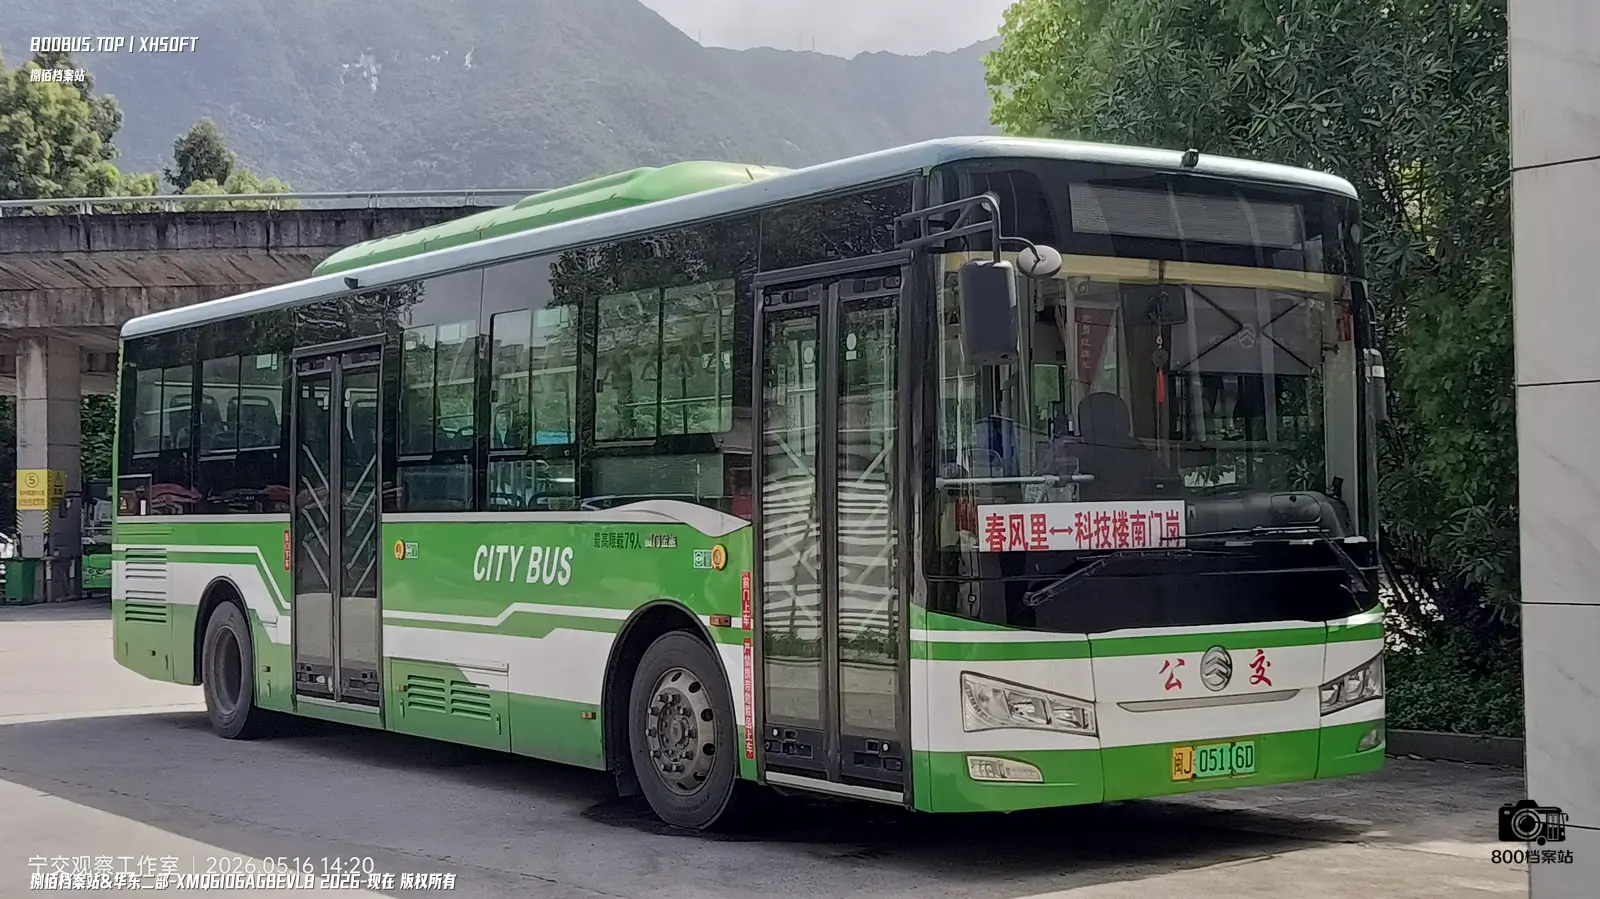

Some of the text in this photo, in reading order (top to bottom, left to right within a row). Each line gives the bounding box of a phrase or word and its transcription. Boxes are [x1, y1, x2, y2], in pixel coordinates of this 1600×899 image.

[594, 532, 642, 549] 最高限载79人
[985, 510, 1180, 551] 春风里 科技楼南门岗
[473, 545, 574, 586] CITY BUS
[1159, 649, 1272, 691] 公 交
